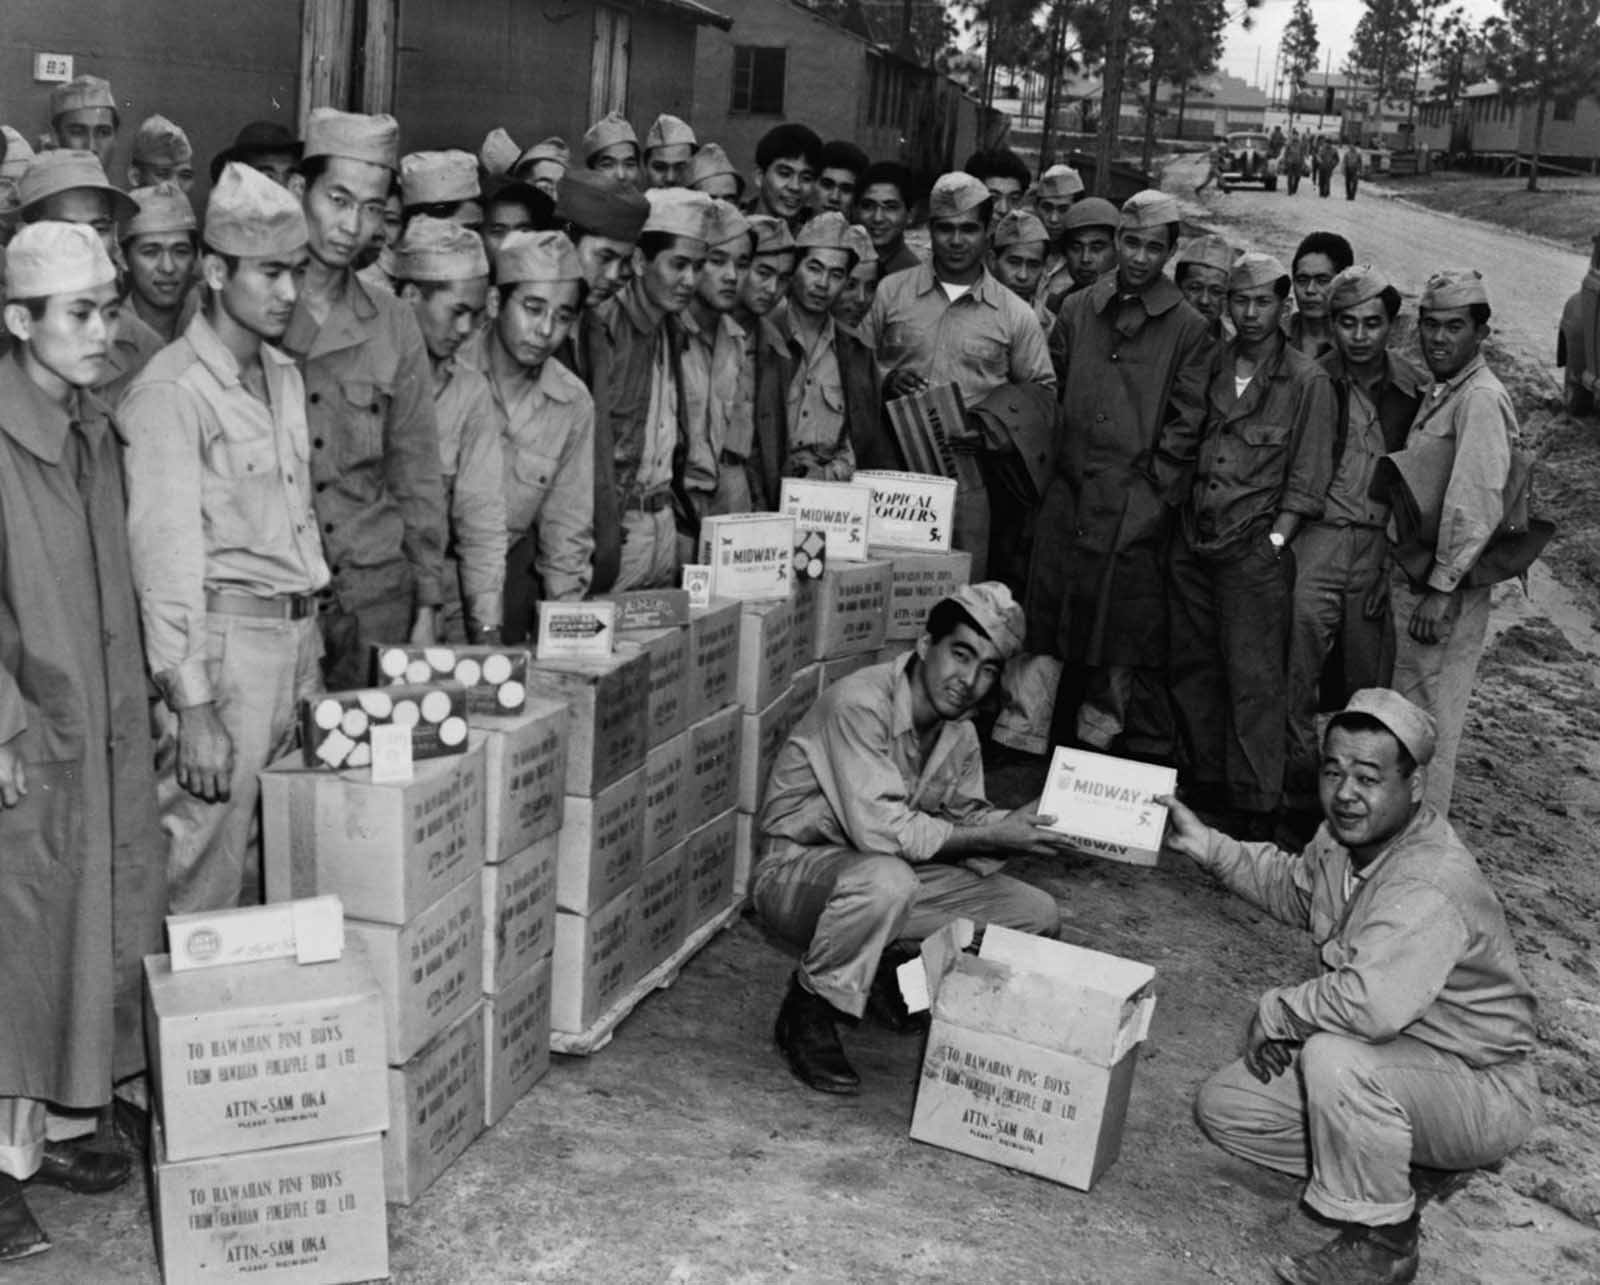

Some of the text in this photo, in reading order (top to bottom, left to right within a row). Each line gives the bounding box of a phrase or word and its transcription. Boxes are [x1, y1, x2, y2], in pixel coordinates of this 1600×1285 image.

[872, 491, 932, 508] ROPICAL
[800, 507, 850, 525] MIDWAY
[875, 505, 937, 523] OOLERS
[733, 547, 778, 563] MIDWAY
[1073, 779, 1141, 803] MIDWAY
[188, 1043, 204, 1060] TO
[947, 1046, 960, 1062] TO
[301, 1090, 326, 1108] OKA
[1023, 1126, 1044, 1146] OKA
[189, 1188, 205, 1206] TO
[311, 1170, 343, 1190] BOYS
[301, 1235, 327, 1252] OKA
